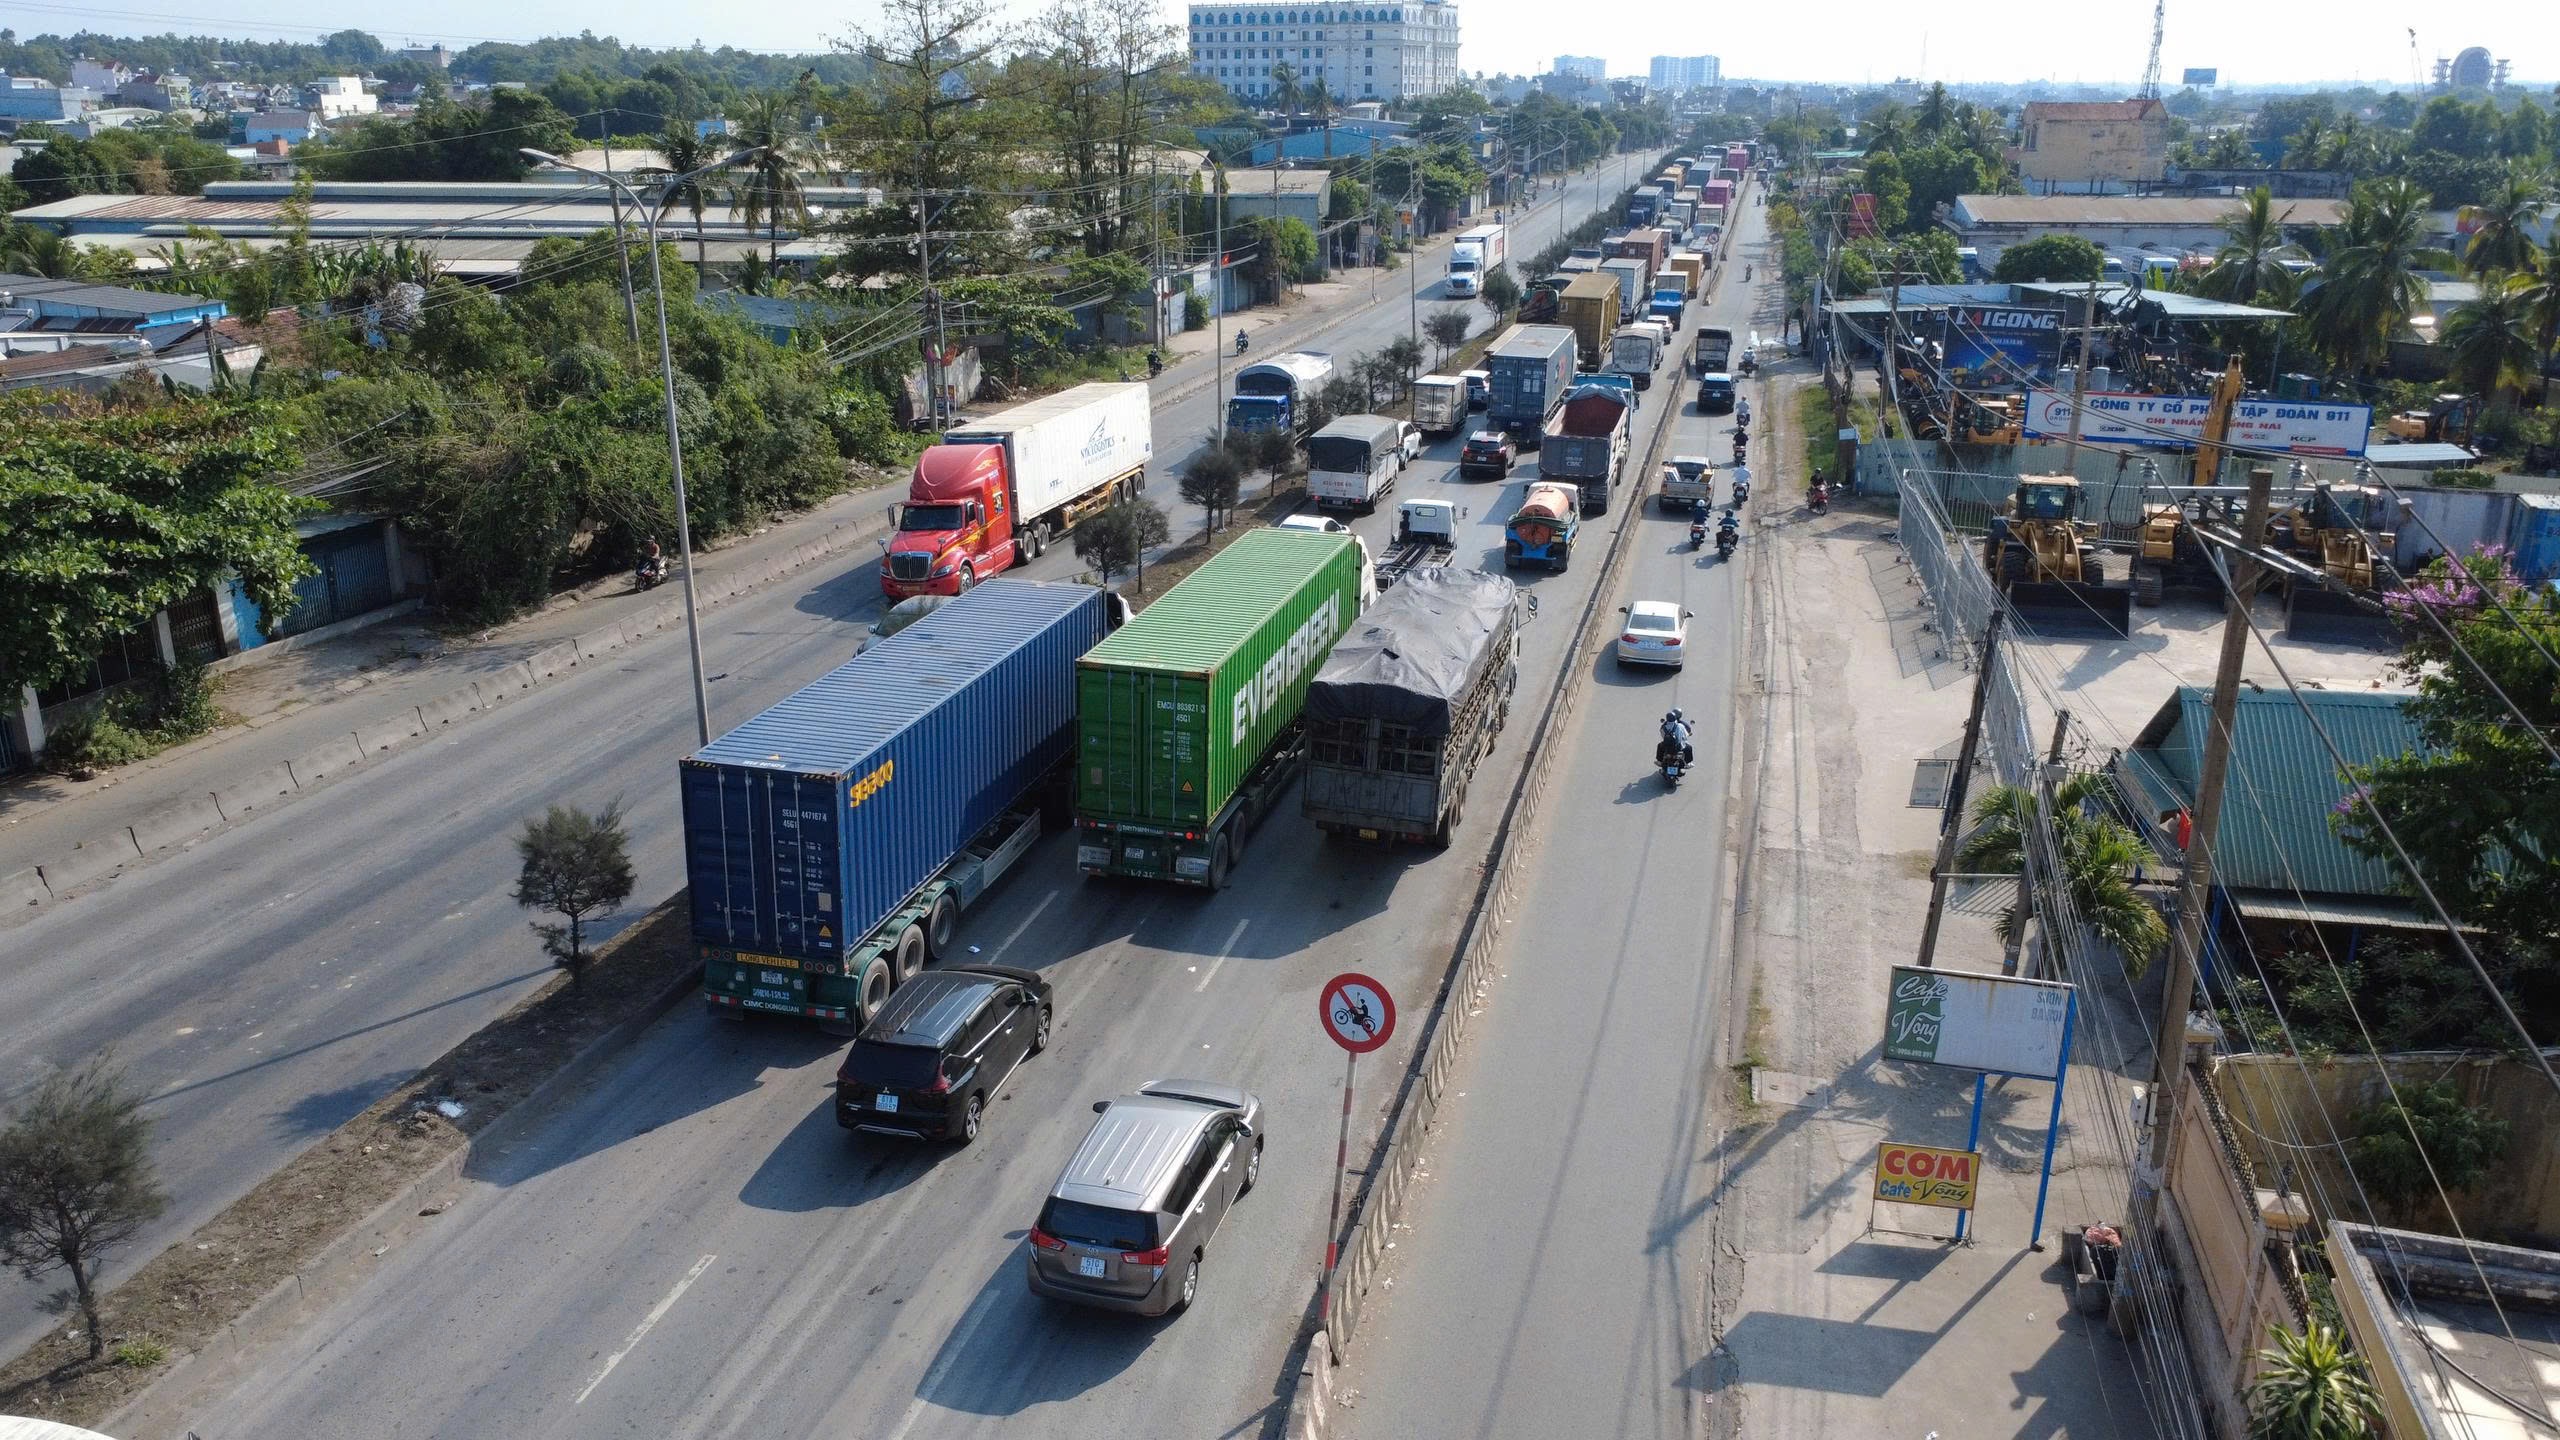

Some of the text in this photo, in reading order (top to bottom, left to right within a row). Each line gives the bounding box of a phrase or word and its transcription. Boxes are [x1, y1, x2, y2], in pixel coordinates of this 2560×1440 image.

[1956, 310, 2056, 329] LAIGONG
[2090, 396, 2130, 411] CÔNG
[2138, 402, 2155, 412] TY
[2240, 403, 2268, 419] TẬP
[2276, 405, 2319, 421] ĐOÀN
[2326, 410, 2350, 421] 911
[1233, 589, 1340, 748] EVERGREEN
[742, 1000, 765, 1009] CIMC
[1884, 1149, 1970, 1182] CƠM
[1879, 1180, 1912, 1198] Cafe
